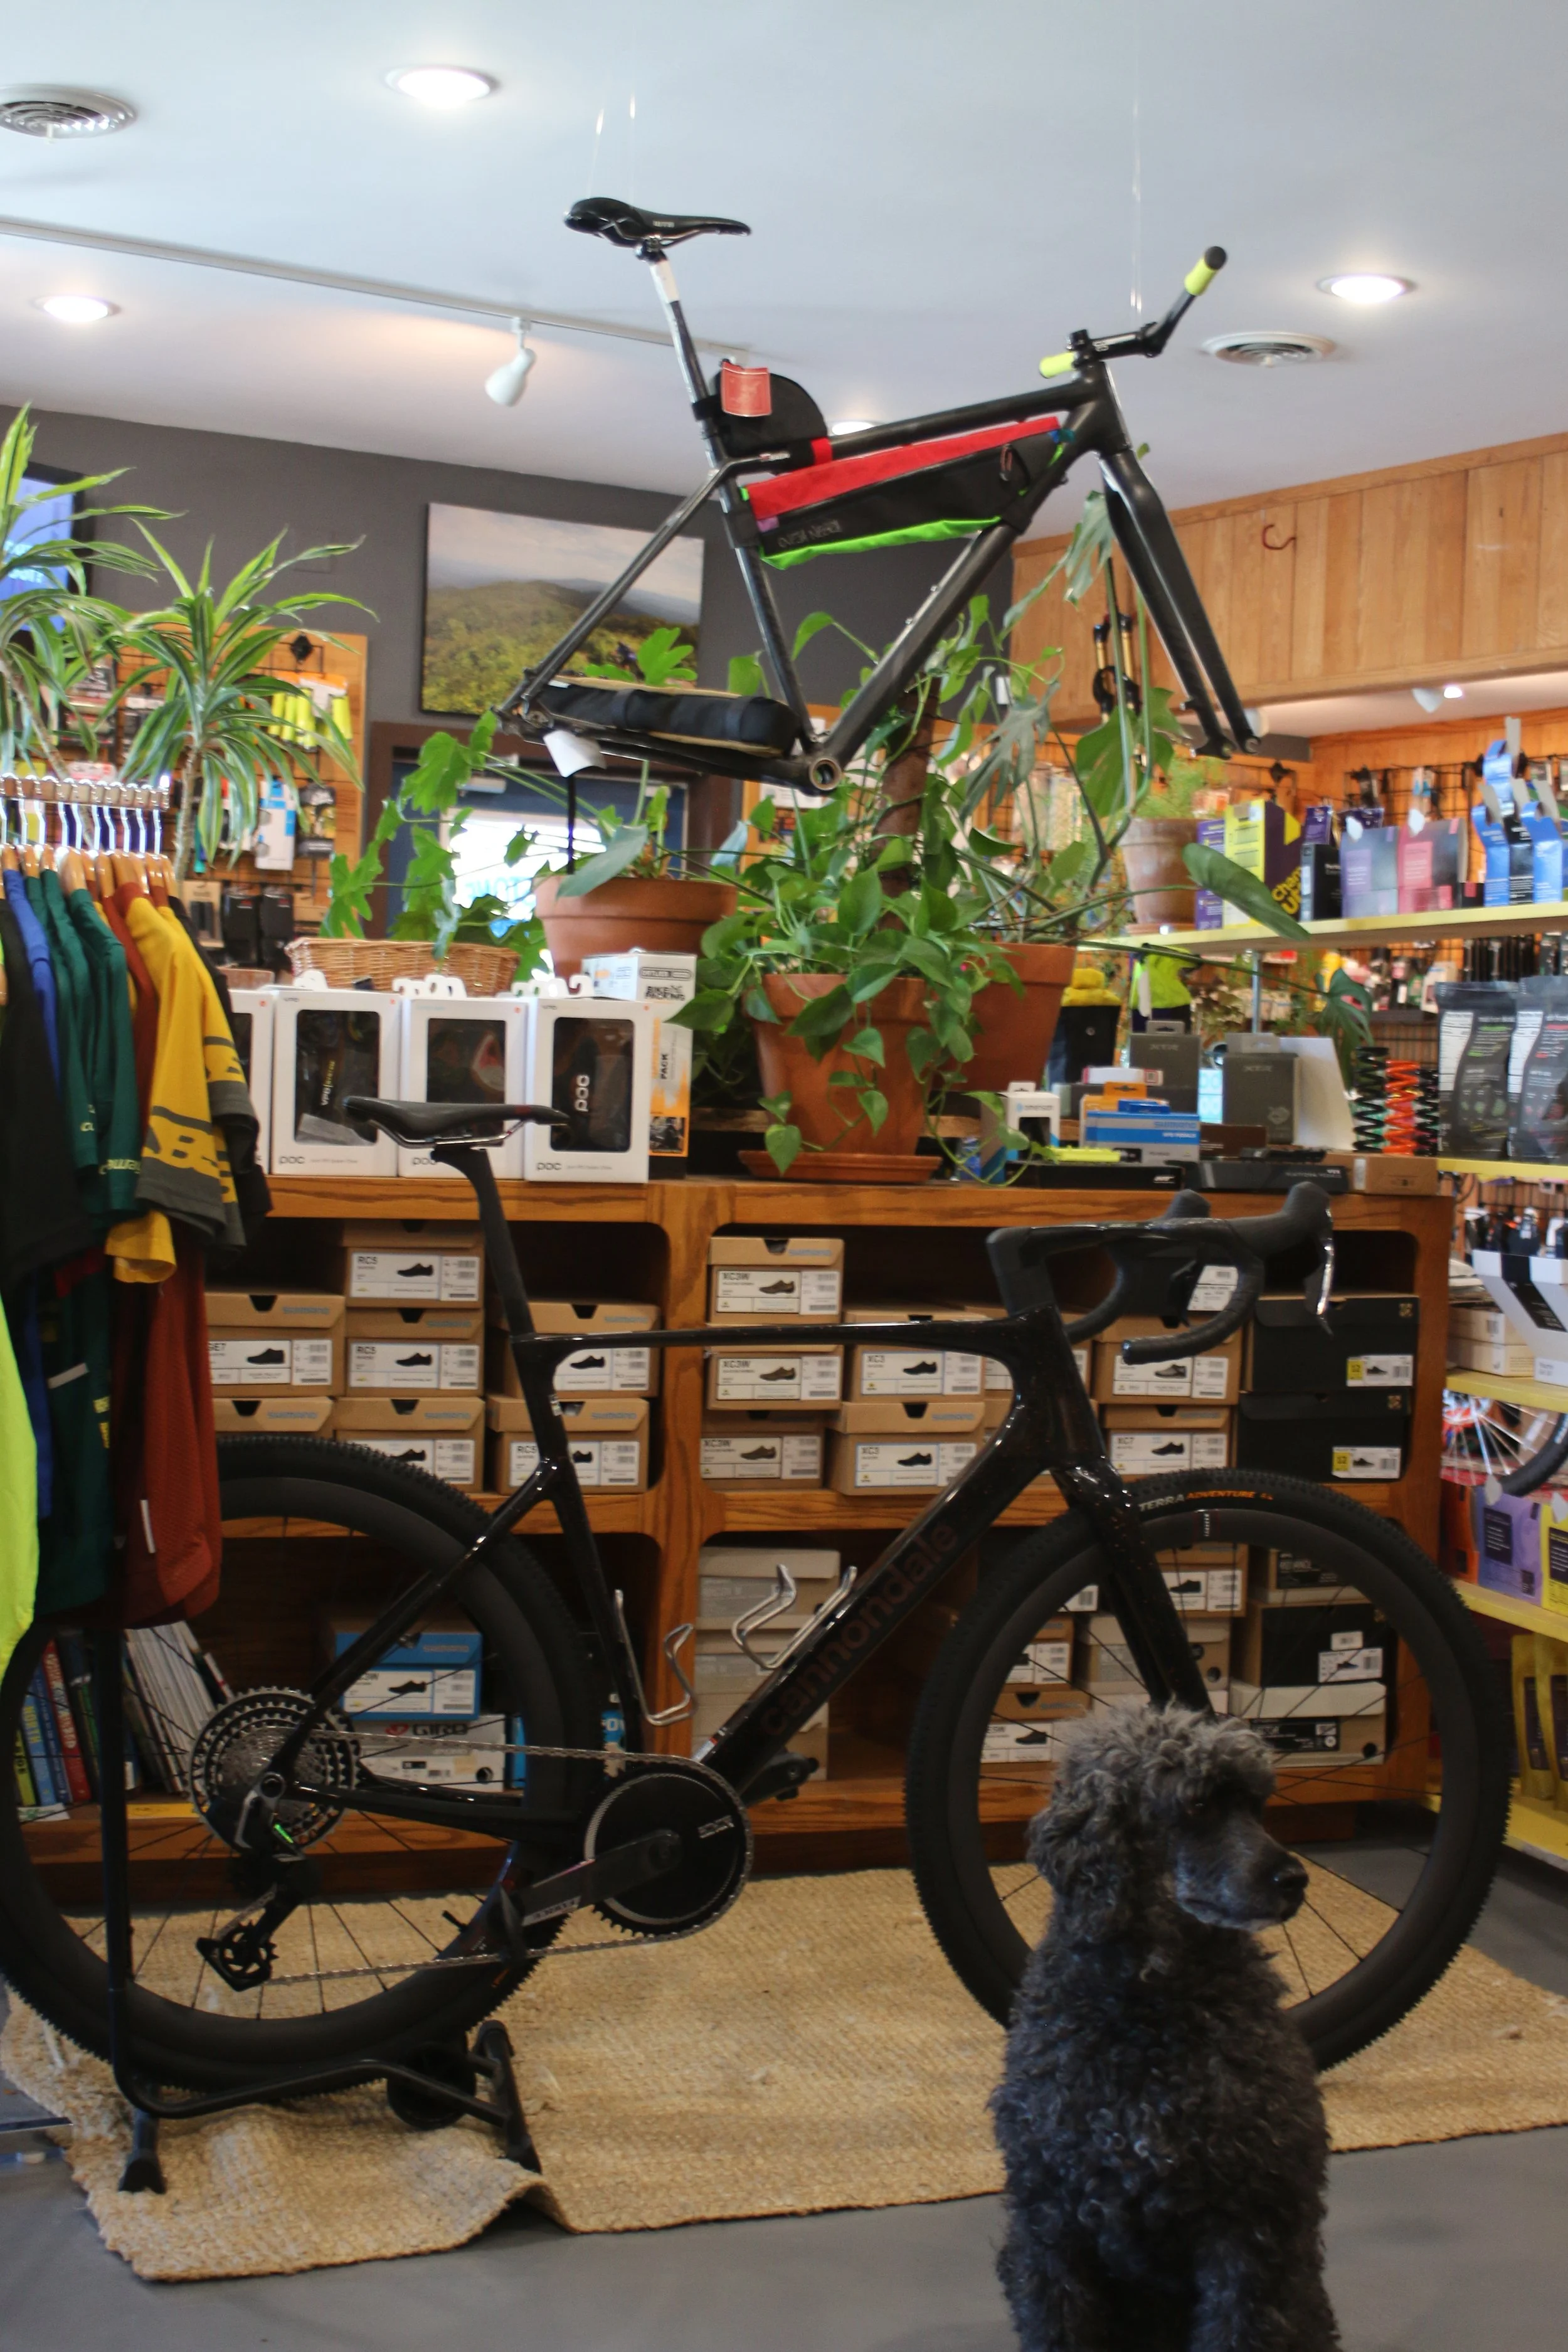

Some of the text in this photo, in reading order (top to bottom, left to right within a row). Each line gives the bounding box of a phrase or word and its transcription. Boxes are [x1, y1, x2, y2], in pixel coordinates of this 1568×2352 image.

[1139, 1494, 1185, 1512] TERRA
[1186, 1490, 1256, 1500] ADVENTURE
[759, 1520, 958, 1737] cannondale
[412, 1724, 468, 1736] GIRO
